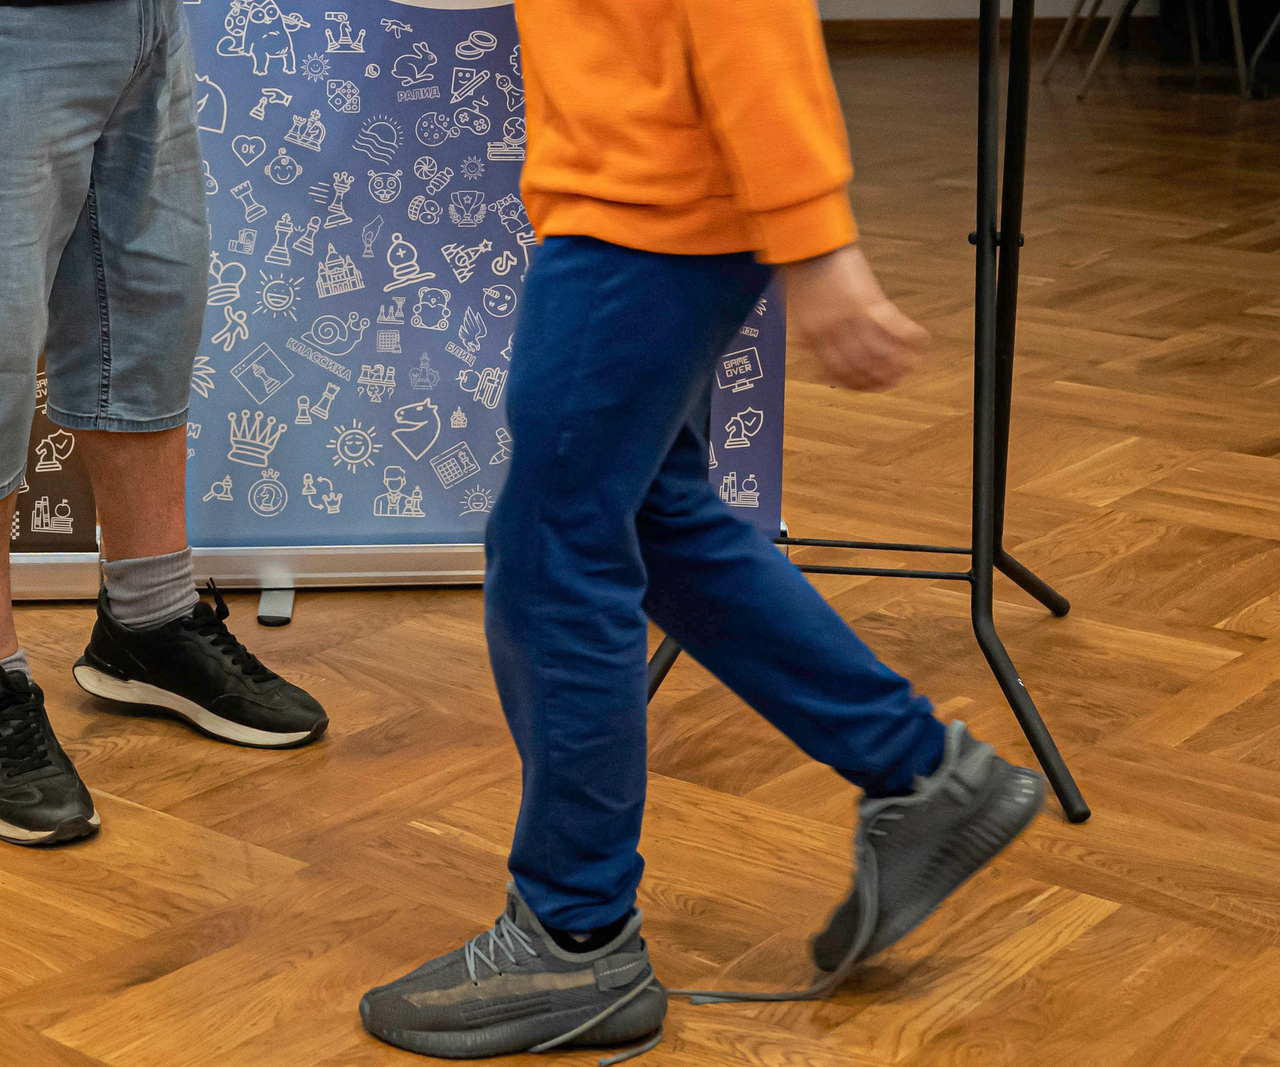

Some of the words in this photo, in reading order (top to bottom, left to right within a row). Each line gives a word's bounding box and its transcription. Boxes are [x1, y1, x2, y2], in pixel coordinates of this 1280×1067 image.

[397, 86, 441, 102] РАПИД
[241, 143, 256, 155] OK
[285, 337, 352, 382] КЛАССИКА
[444, 341, 477, 367] БЛИЦ
[723, 355, 751, 370] GAME
[725, 363, 753, 378] OVER
